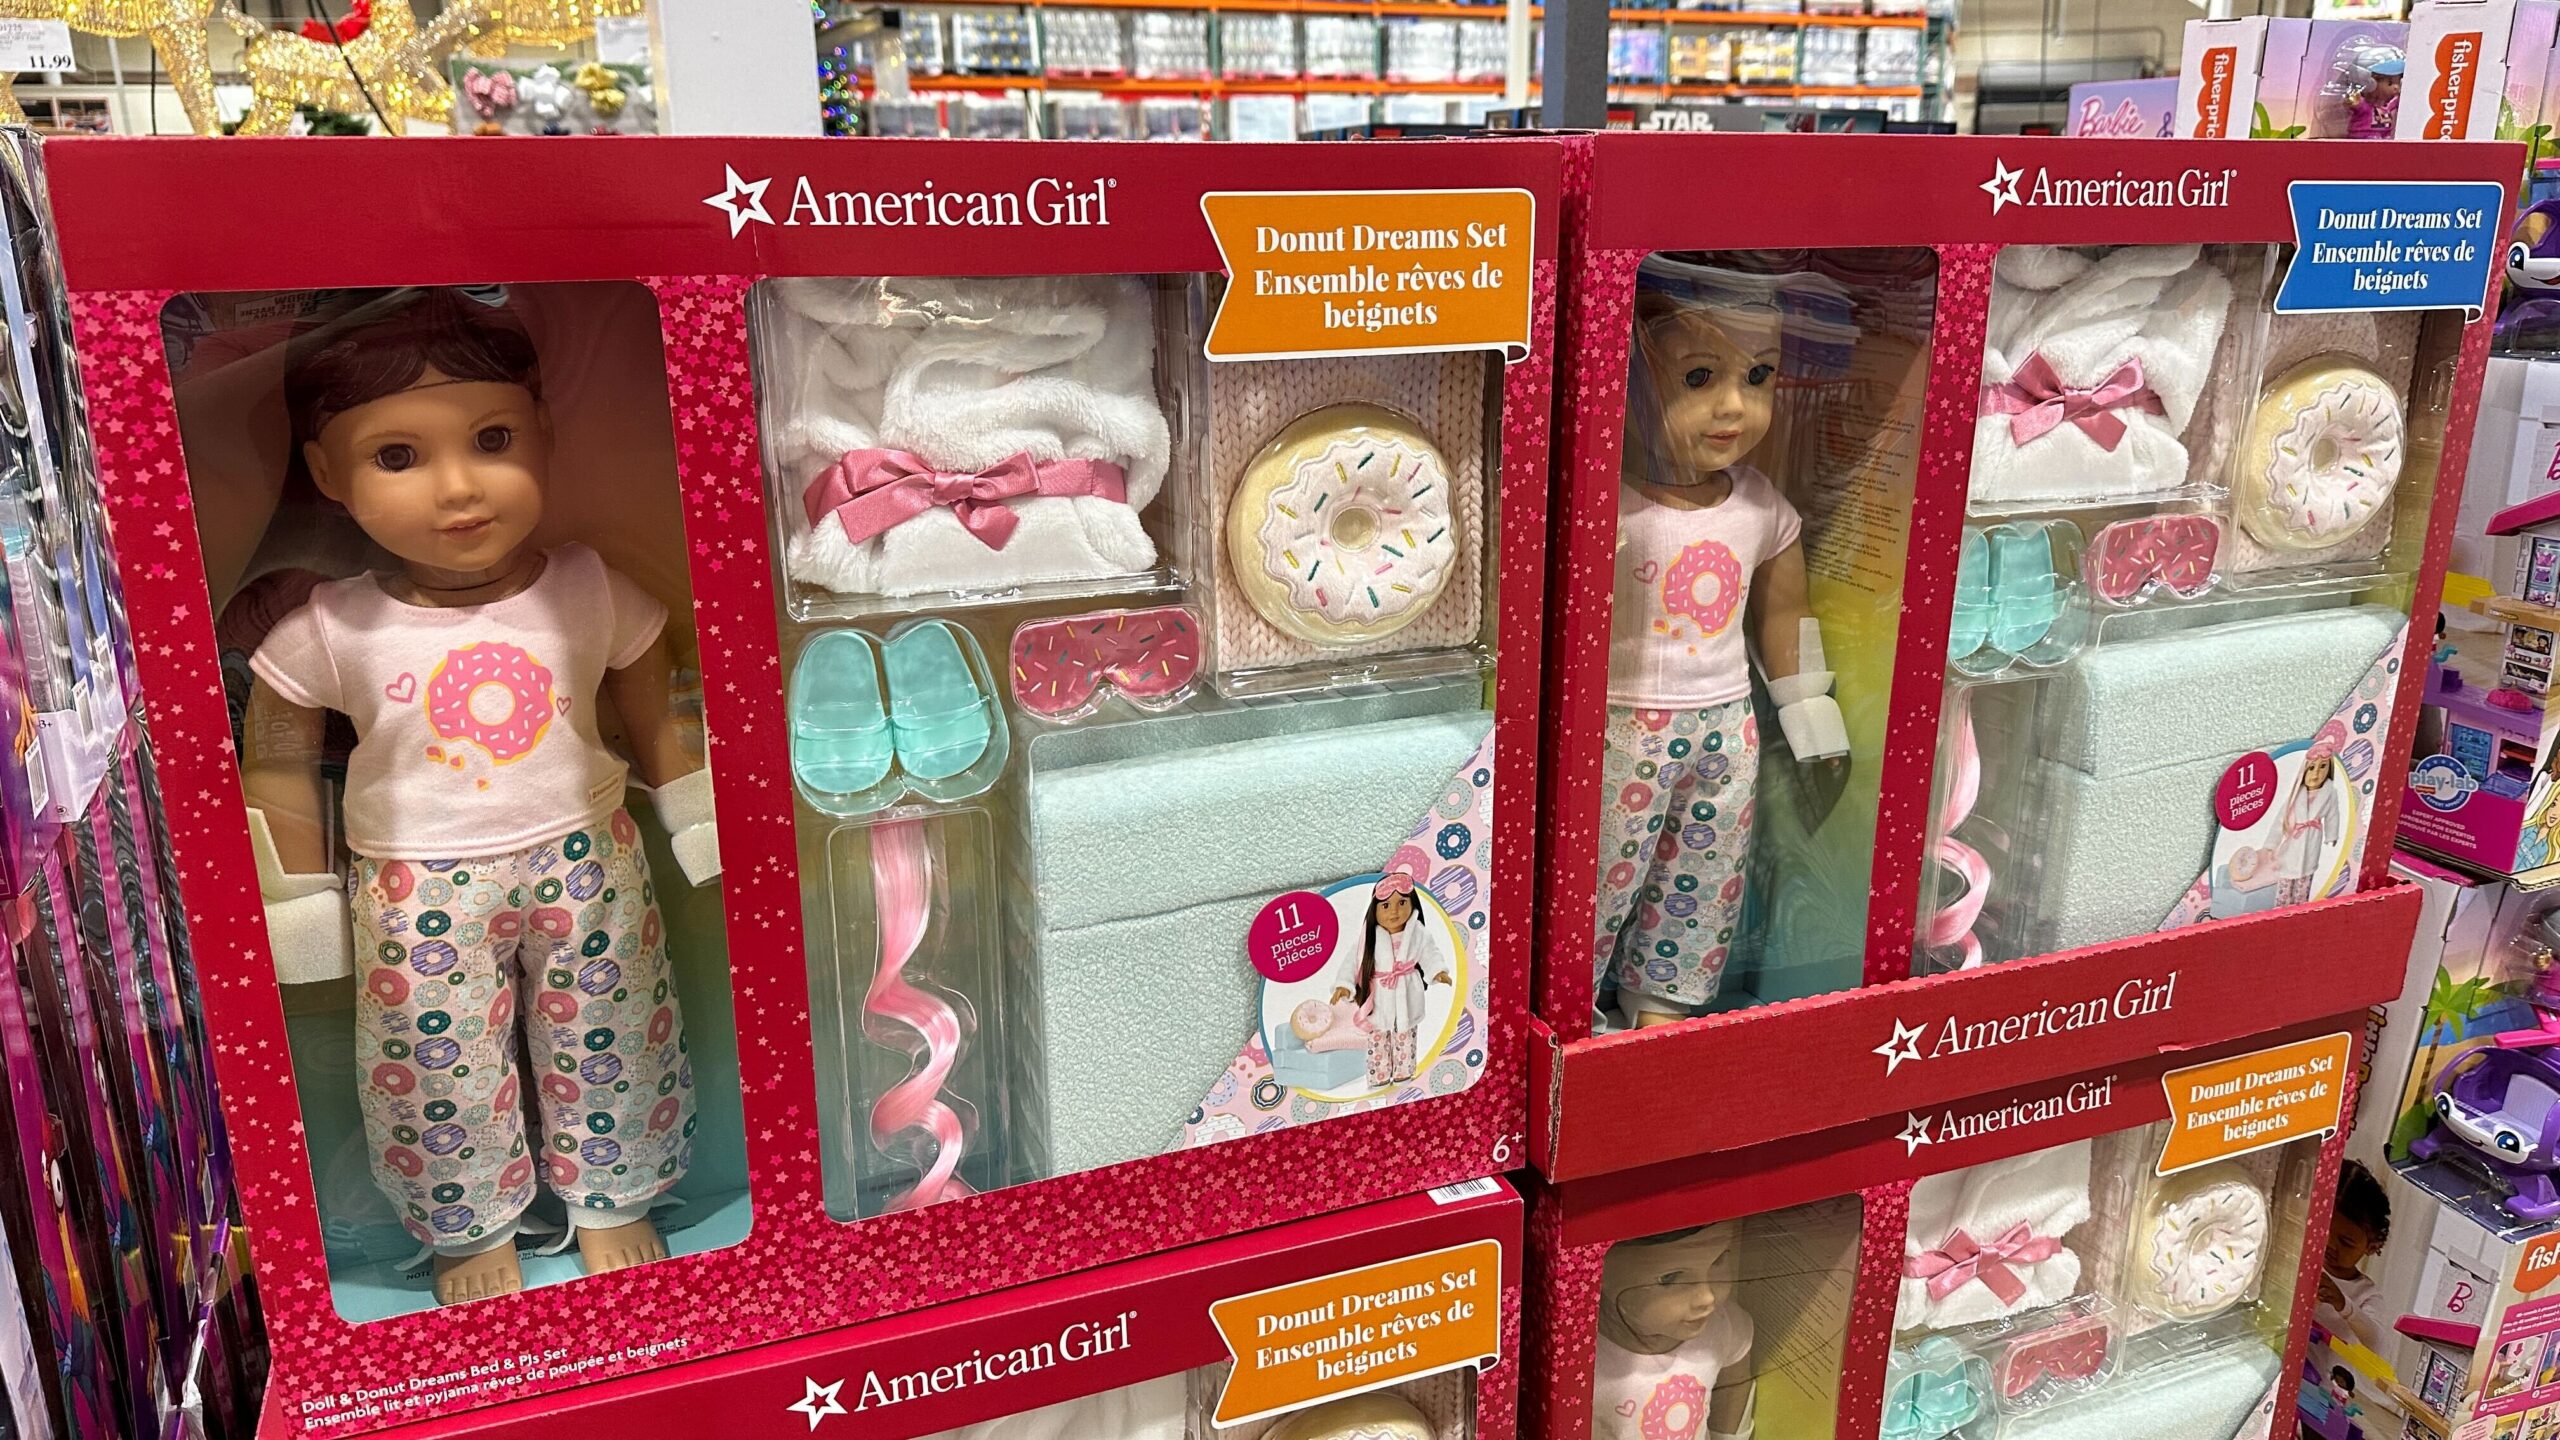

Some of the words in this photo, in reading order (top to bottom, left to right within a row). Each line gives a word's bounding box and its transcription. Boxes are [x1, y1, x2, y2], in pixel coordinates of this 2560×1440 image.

[30, 54, 72, 69] 11.99
[2205, 53, 2230, 138] fisher-pric
[1639, 110, 1715, 131] STAR
[2077, 96, 2144, 137] Barbie
[783, 175, 1023, 226] American
[2026, 167, 2174, 207] American
[2317, 208, 2378, 230] Donut
[2379, 208, 2451, 229] Dreams
[2454, 207, 2483, 229] Set
[1256, 226, 1346, 253] Donut
[1351, 224, 1459, 251] Dreams
[1465, 222, 1508, 249] Set
[2311, 240, 2401, 264] Ensemble
[2403, 238, 2452, 262] rêves
[2453, 240, 2475, 262] de
[1253, 264, 1389, 296] Ensemble
[1396, 261, 1465, 292] rêves
[1471, 261, 1503, 289] de
[2353, 268, 2429, 295] beignets
[1323, 300, 1438, 333] beignets
[2237, 763, 2256, 789] 11
[2410, 769, 2478, 791] play-lab
[2229, 783, 2267, 810] pieces/
[2412, 809, 2434, 820] EXPERT
[2434, 817, 2466, 830] APPROVED
[1275, 903, 1304, 934] 11
[1270, 924, 1321, 959] pieces/
[1928, 997, 2108, 1059] American
[2112, 971, 2178, 1019] Girl
[2190, 1077, 2242, 1104] Donut
[2244, 1063, 2306, 1090] Dreams
[2308, 1056, 2334, 1075] Set
[1936, 1095, 2065, 1144] American
[2187, 1096, 2263, 1130] Ensemble
[2266, 1089, 2307, 1110] rêves
[2309, 1081, 2328, 1098] de
[2223, 1113, 2289, 1142] beignets
[1492, 1131, 1523, 1163] 6+
[1257, 1301, 1336, 1338] Donut
[1341, 1280, 1435, 1317] Dreams
[1440, 1267, 1478, 1293] Set
[1255, 1324, 1375, 1370] Ensemble
[1380, 1308, 1441, 1340] rêves
[1447, 1300, 1475, 1322] de
[853, 1340, 1056, 1413] American
[1317, 1340, 1418, 1381] beignets
[302, 1395, 335, 1414] Doll
[339, 1392, 353, 1406] &
[355, 1382, 405, 1401] Donut
[409, 1370, 467, 1391] Dreams
[470, 1360, 500, 1377] Bed
[503, 1358, 515, 1370] &
[519, 1354, 540, 1368] PJs
[544, 1347, 568, 1362] Set
[305, 1404, 381, 1430] Ensemble
[383, 1398, 400, 1413] lit
[404, 1394, 421, 1407] et
[425, 1384, 479, 1405] pyjama
[483, 1374, 523, 1390] rêves
[526, 1369, 545, 1382] de
[549, 1354, 605, 1380] poupée
[608, 1350, 624, 1363] et
[627, 1337, 688, 1360] beignets
